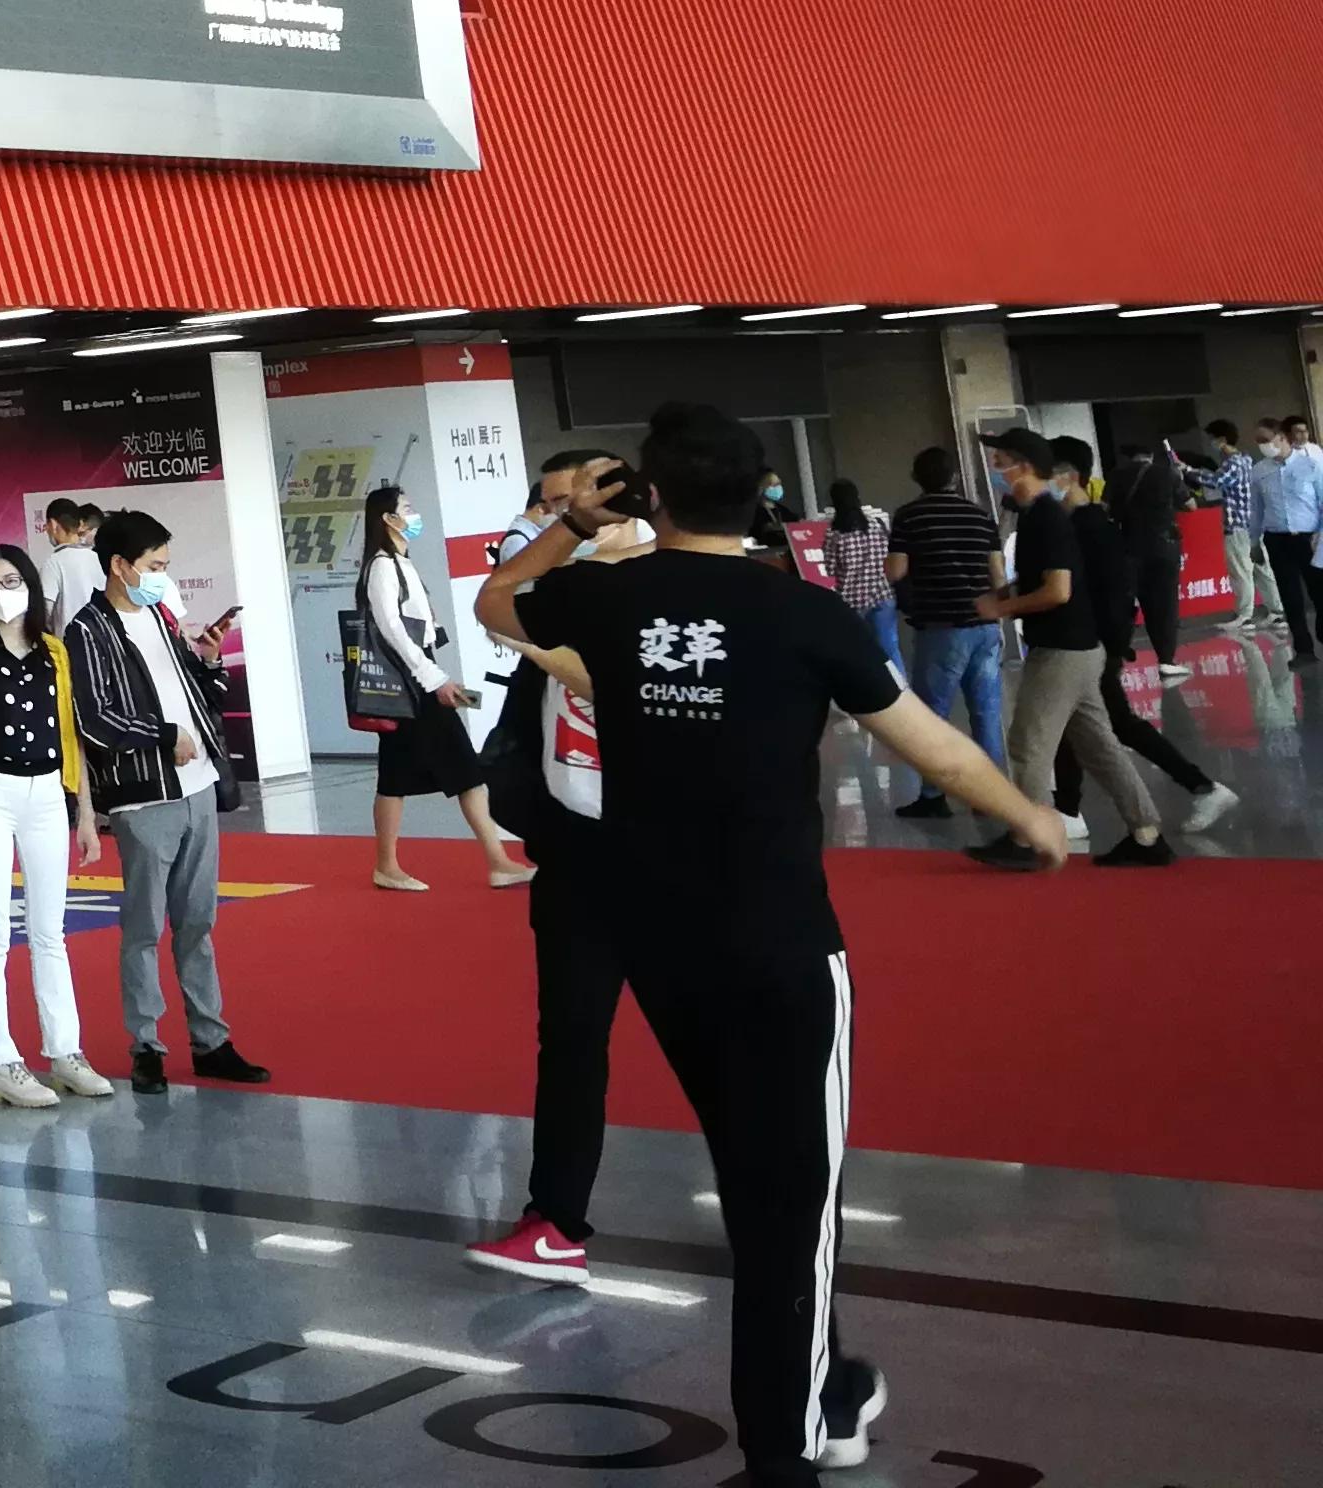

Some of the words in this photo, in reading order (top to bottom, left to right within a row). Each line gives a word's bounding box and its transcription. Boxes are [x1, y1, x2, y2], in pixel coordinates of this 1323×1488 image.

[263, 360, 307, 379] mplex
[122, 428, 205, 456] 欢迎光临
[451, 428, 475, 447] Hall
[478, 425, 502, 444] 展厅
[123, 456, 211, 479] WELCOME
[639, 617, 728, 678] 变革
[639, 683, 724, 704] CHANGE
